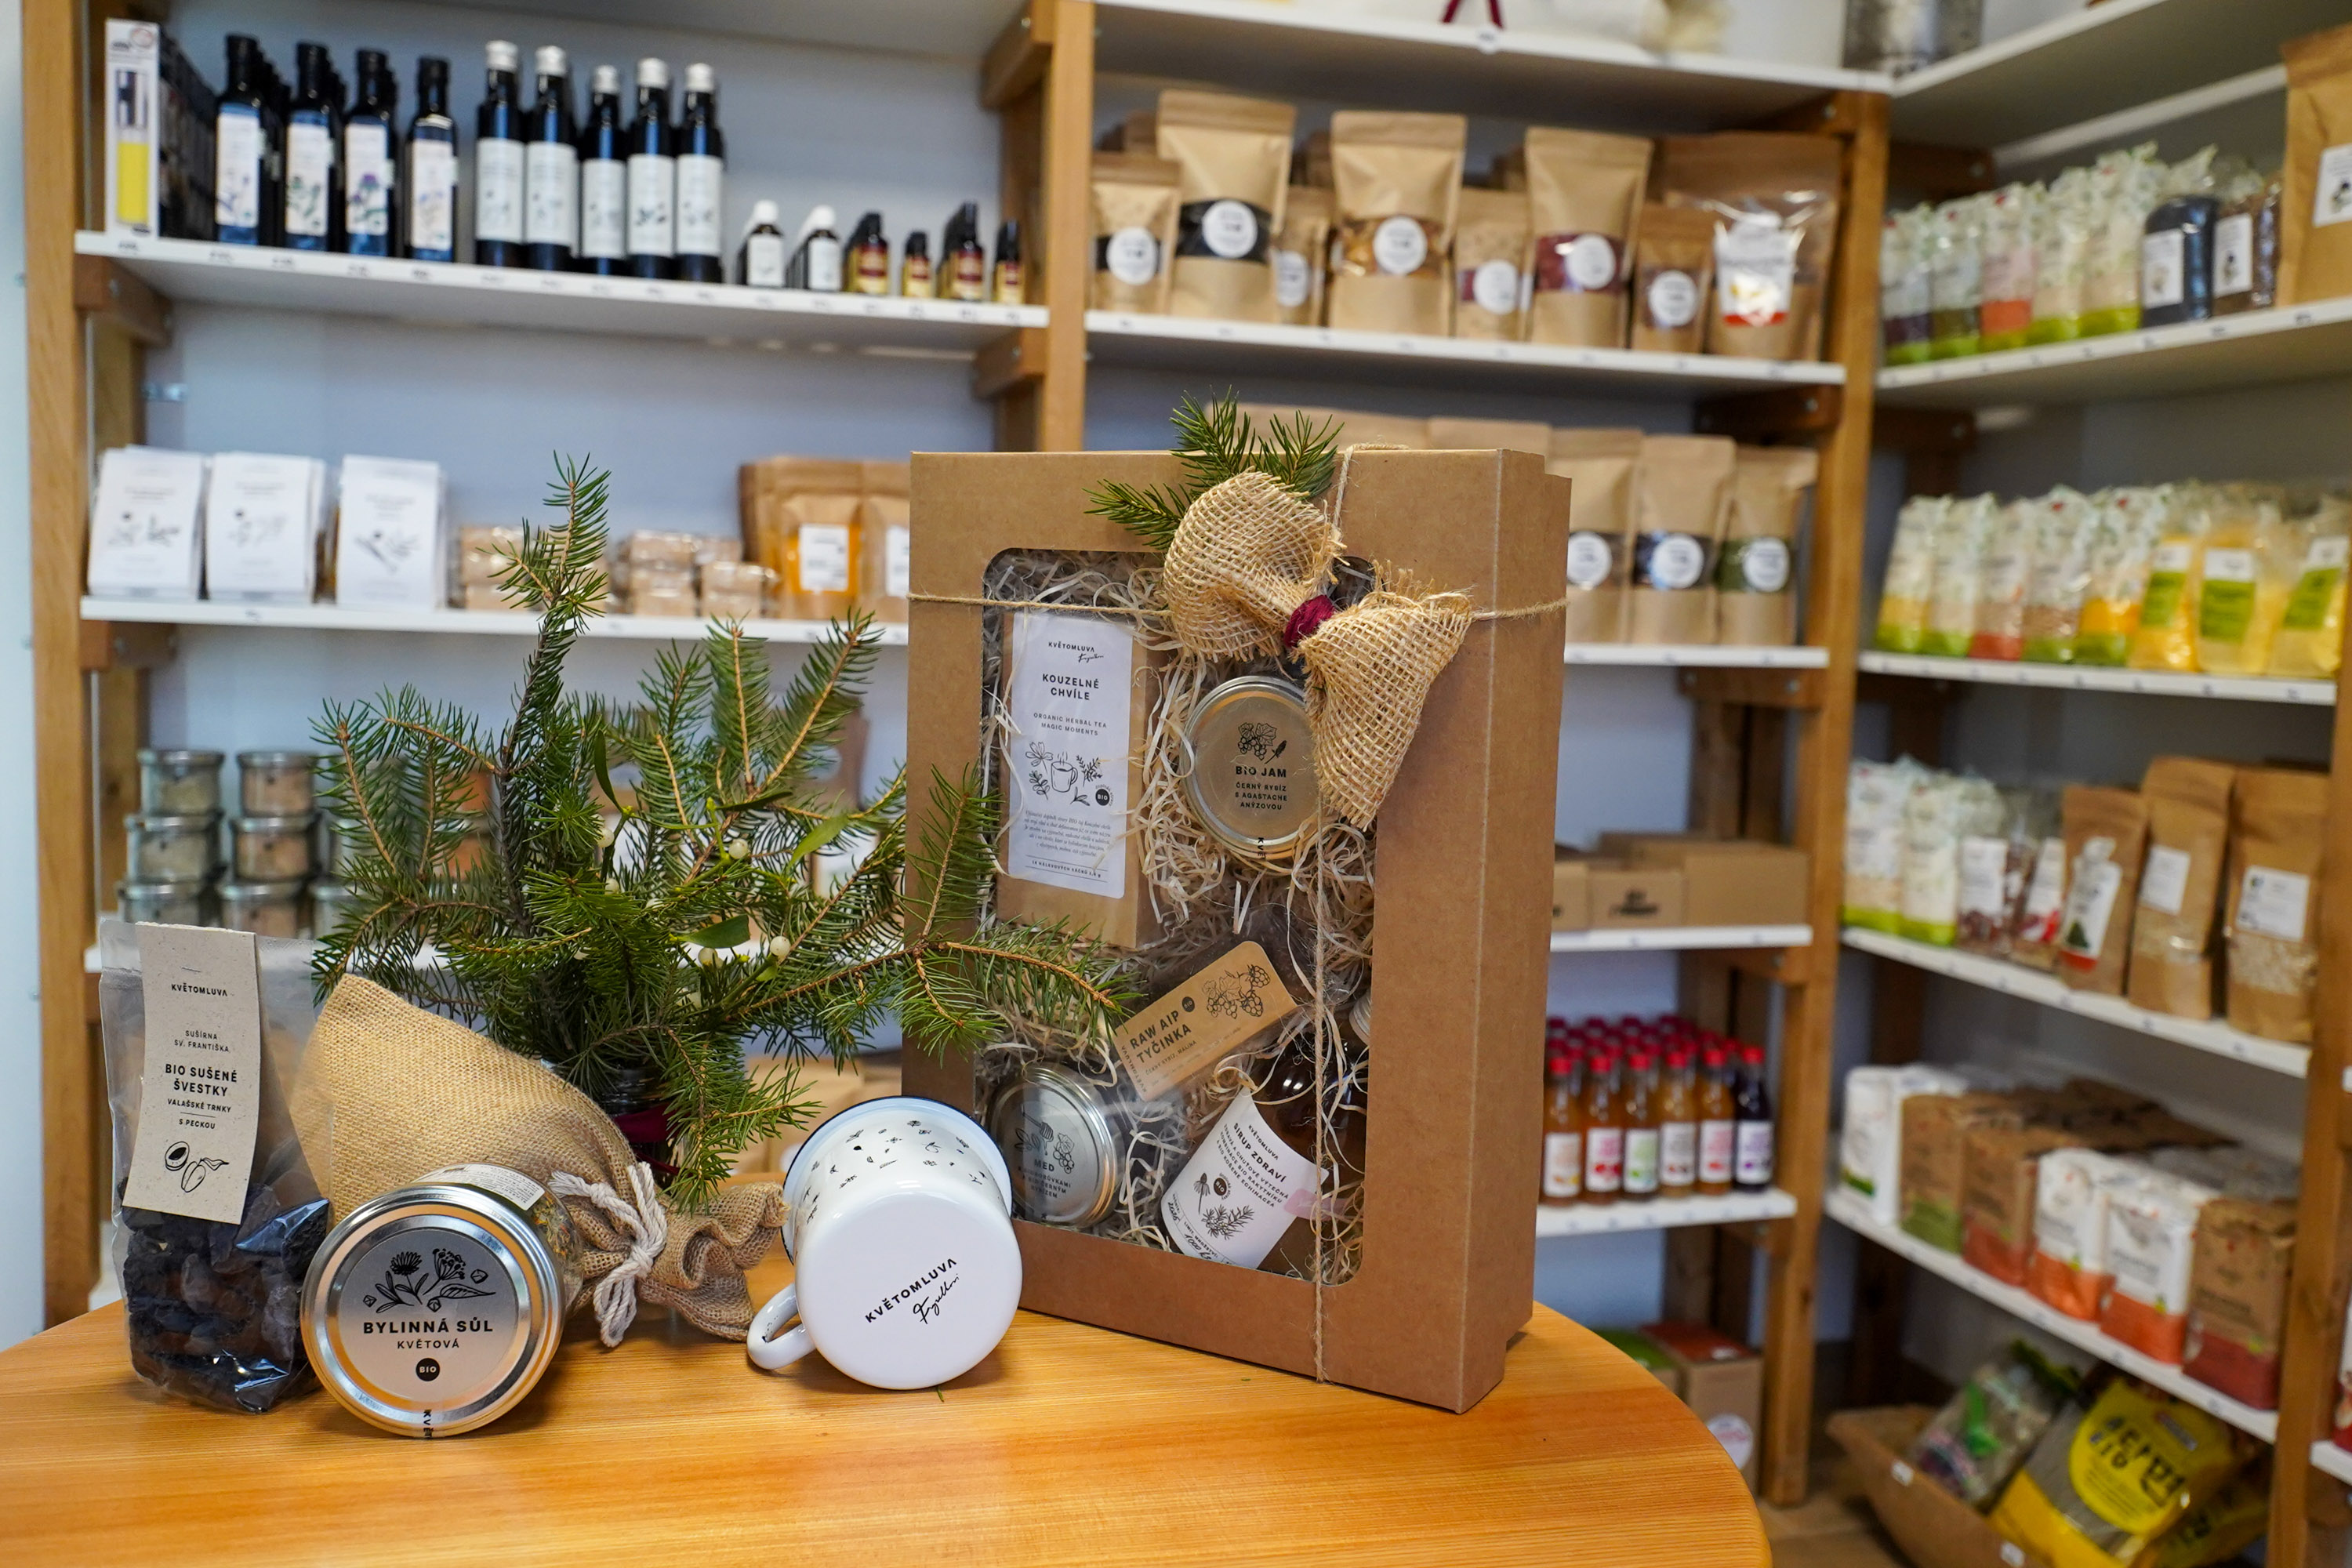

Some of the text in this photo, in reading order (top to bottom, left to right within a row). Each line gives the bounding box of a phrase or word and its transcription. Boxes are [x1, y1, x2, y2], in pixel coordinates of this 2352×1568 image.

[1048, 641, 1094, 652] KVĚTOMLUVA
[1042, 673, 1099, 689] KOUZELNÉ
[1051, 687, 1090, 701] CHVÍLE
[1033, 713, 1064, 723] ORGANIC
[1065, 716, 1092, 726] HERBAL
[1041, 723, 1098, 736] MAGIC MOMENTS
[1236, 766, 1287, 778] BIO JAM
[1236, 782, 1287, 792] ČERNÝ RYBÍZ
[1242, 793, 1287, 801] AGASTACHE
[1240, 801, 1282, 811] ANÝZOVOU
[171, 982, 227, 996] KVĚTOMLUVA
[185, 1029, 218, 1040] SUŠÍRNA
[1130, 1010, 1179, 1049] RAW AIP
[174, 1039, 230, 1052] SV. FRANTIŠKA
[1137, 1024, 1192, 1063] TYČINKA
[165, 1063, 238, 1083] BIO SUŠENÉ
[173, 1078, 228, 1097] ŠVESTKY
[167, 1098, 231, 1113] VALAŠSKÉ TRNKY
[185, 1119, 216, 1129] PECKOU
[1248, 1124, 1279, 1160] KVĚTOMLUVA
[1233, 1123, 1287, 1182] SIRUP ZDRAVÍ
[1034, 1160, 1054, 1171] MED
[1215, 1181, 1224, 1192] BIO
[1223, 1156, 1241, 1179] KOŘENE
[1241, 1179, 1275, 1208] ECHINACEA
[1238, 1165, 1247, 1175] BIO
[1248, 1176, 1283, 1203] RAKYTNÍKU
[1261, 1178, 1289, 1199] VÝTEČNÁ
[1185, 1234, 1202, 1250] 1000
[866, 1258, 957, 1323] KVĚTOMLUVA
[363, 1316, 493, 1334] BYLINNÁ SŮL
[397, 1338, 459, 1349] KVĚTOVÁ
